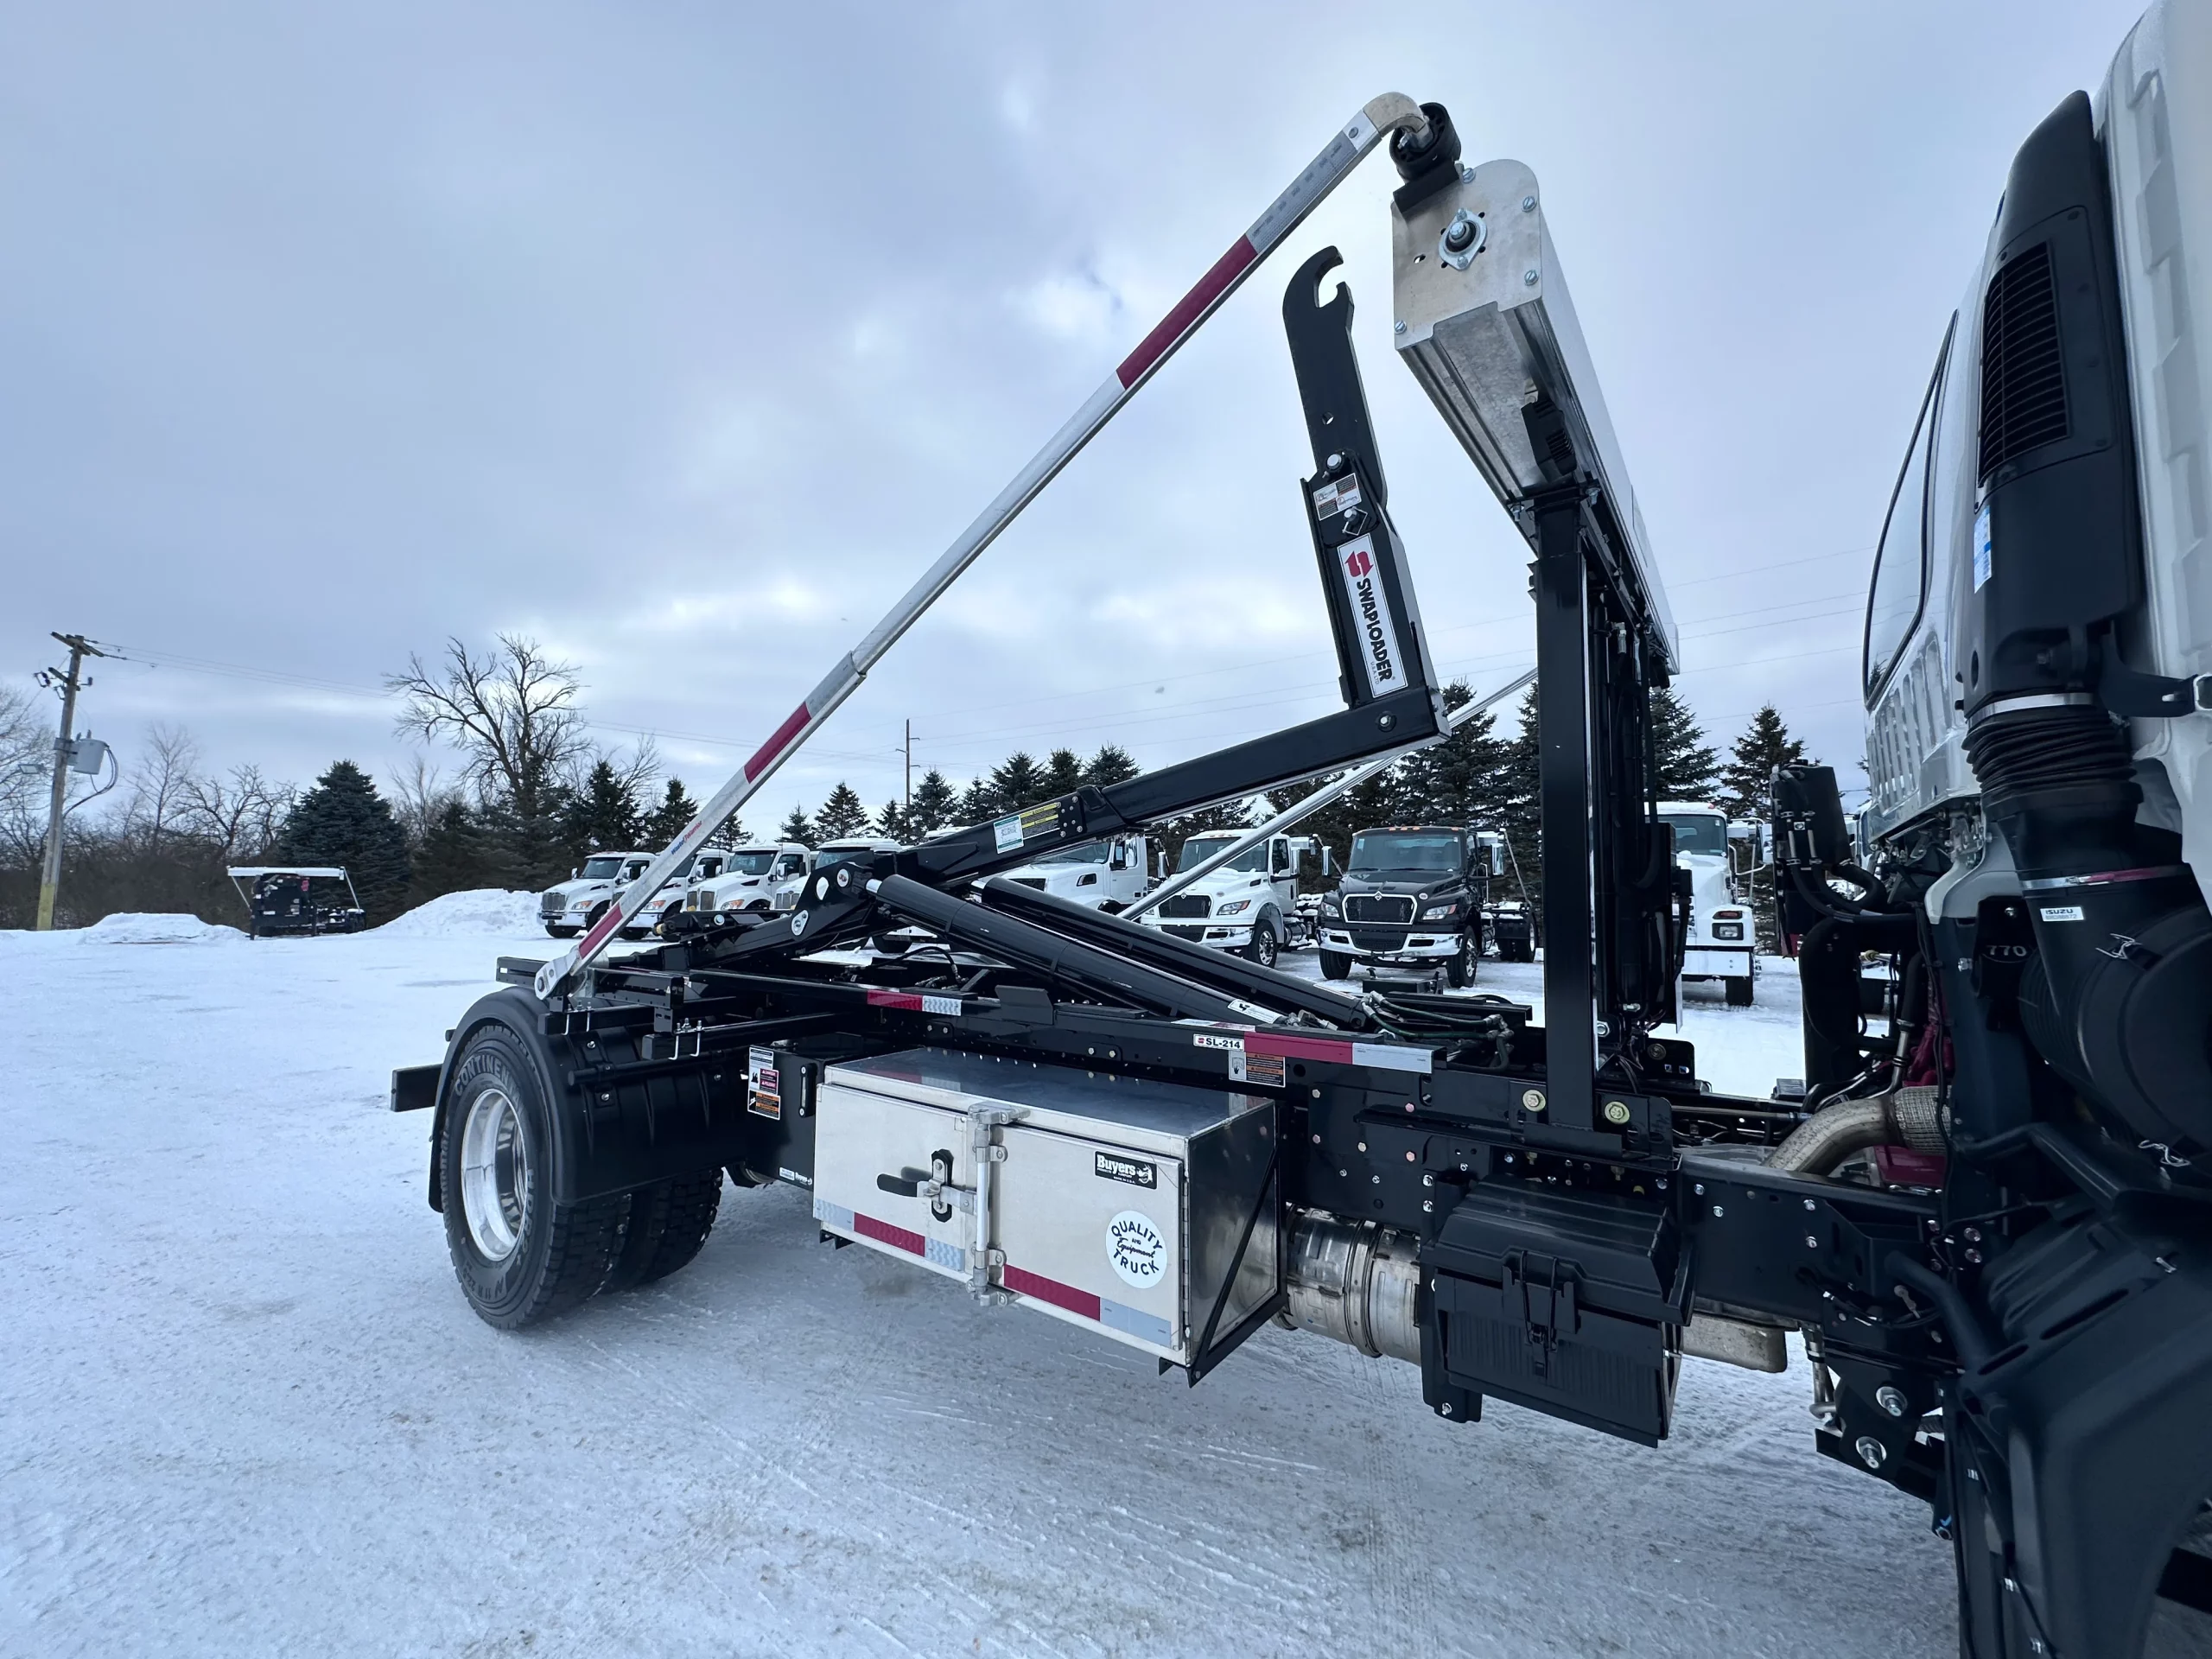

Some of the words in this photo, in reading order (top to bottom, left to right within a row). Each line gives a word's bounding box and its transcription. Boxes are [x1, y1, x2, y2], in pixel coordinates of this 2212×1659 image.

[1357, 577, 1393, 683] SWAPLOADER
[1986, 944, 2027, 957] 770
[1206, 1038, 1240, 1049] SL-214
[1096, 1154, 1136, 1176] Buyers
[1111, 1220, 1163, 1249] QUALITY
[1116, 1237, 1156, 1258] Equipment
[1113, 1248, 1160, 1275] TRUCK
